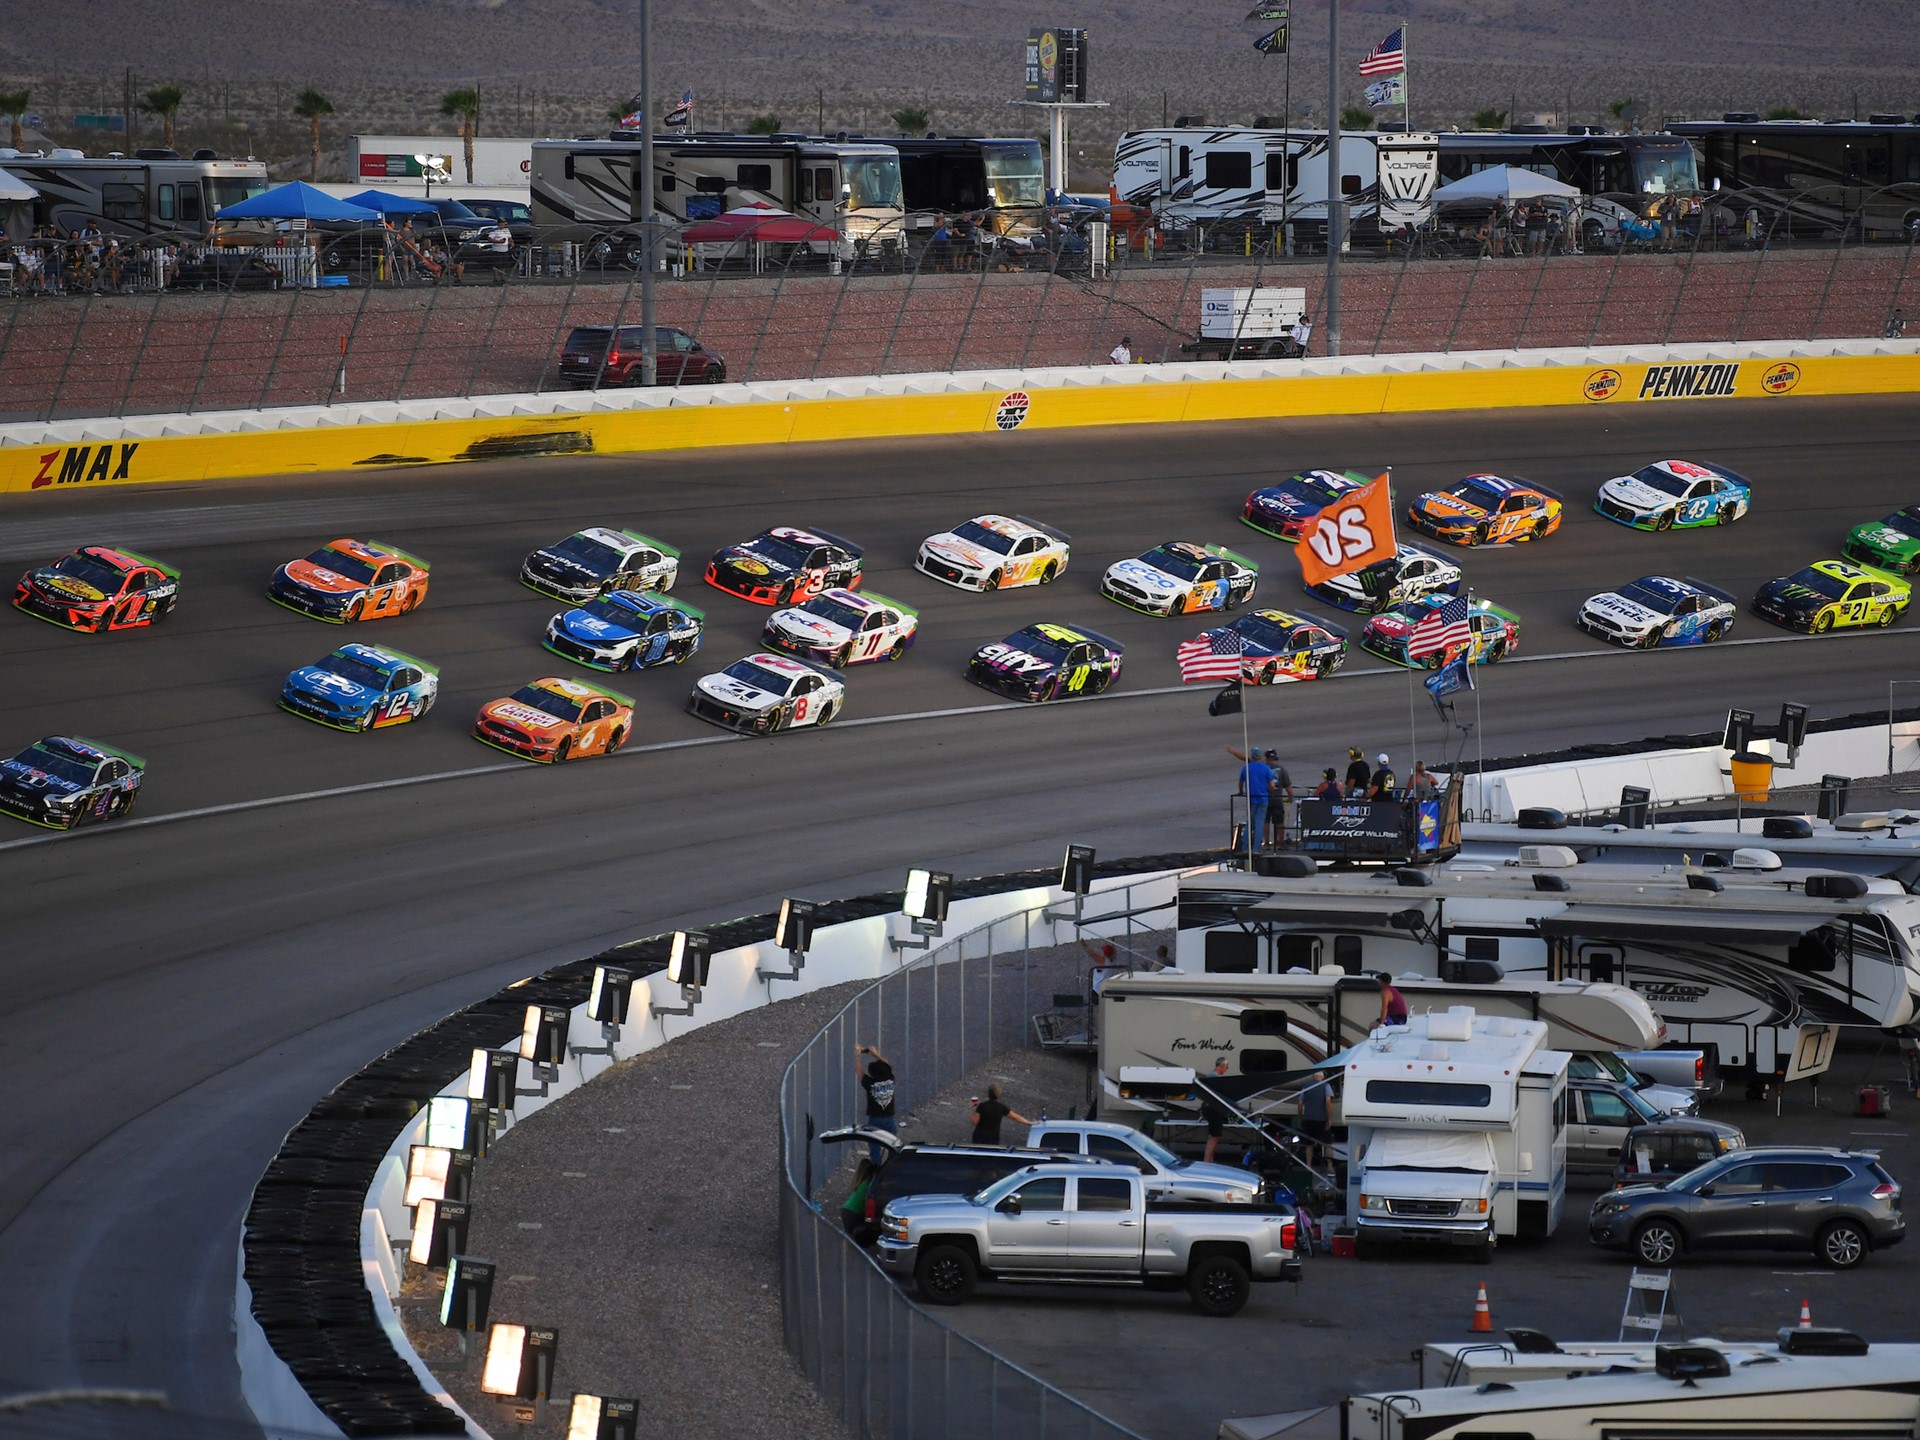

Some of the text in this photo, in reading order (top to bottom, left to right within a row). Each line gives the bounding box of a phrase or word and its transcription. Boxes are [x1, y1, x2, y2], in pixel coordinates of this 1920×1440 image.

[1386, 162, 1432, 170] VOLTAGE
[1638, 363, 1741, 400] PENNZOIL
[1765, 370, 1796, 385] PENNZOIL
[1688, 499, 1710, 519] 43
[1499, 514, 1522, 536] 17
[1857, 533, 1896, 551] clover
[830, 559, 860, 572] TRACKER
[808, 569, 825, 592] 3
[1425, 570, 1457, 585] GEICO
[147, 583, 176, 600] TRACKER
[374, 587, 394, 611] 2
[1197, 585, 1218, 607] 14
[1403, 580, 1425, 601] 13
[1591, 597, 1646, 623] Blinds
[1850, 601, 1870, 621] 21
[780, 610, 838, 638] FedEx
[888, 626, 903, 638] FedEx
[1674, 614, 1699, 637] 38
[862, 632, 884, 656] 11
[978, 644, 1053, 673] ally
[1291, 650, 1311, 673] 95
[1068, 664, 1091, 692] 48
[384, 691, 410, 719] 12
[794, 697, 808, 721] 8
[499, 707, 551, 726] Mayer
[578, 723, 598, 750] 6
[1331, 805, 1371, 816] Mobil 1
[1331, 816, 1367, 828] Racing
[688, 936, 708, 944] musco
[608, 972, 629, 980] musco
[1646, 994, 1699, 1003] CHROME
[545, 1010, 566, 1018] musco
[1171, 1037, 1236, 1052] Four Winds
[491, 1055, 514, 1063] musco
[1407, 1114, 1448, 1124] ITASCA
[441, 1206, 465, 1214] musco
[461, 1266, 488, 1275] musco
[530, 1331, 554, 1340] musco
[608, 1402, 633, 1411] musco
